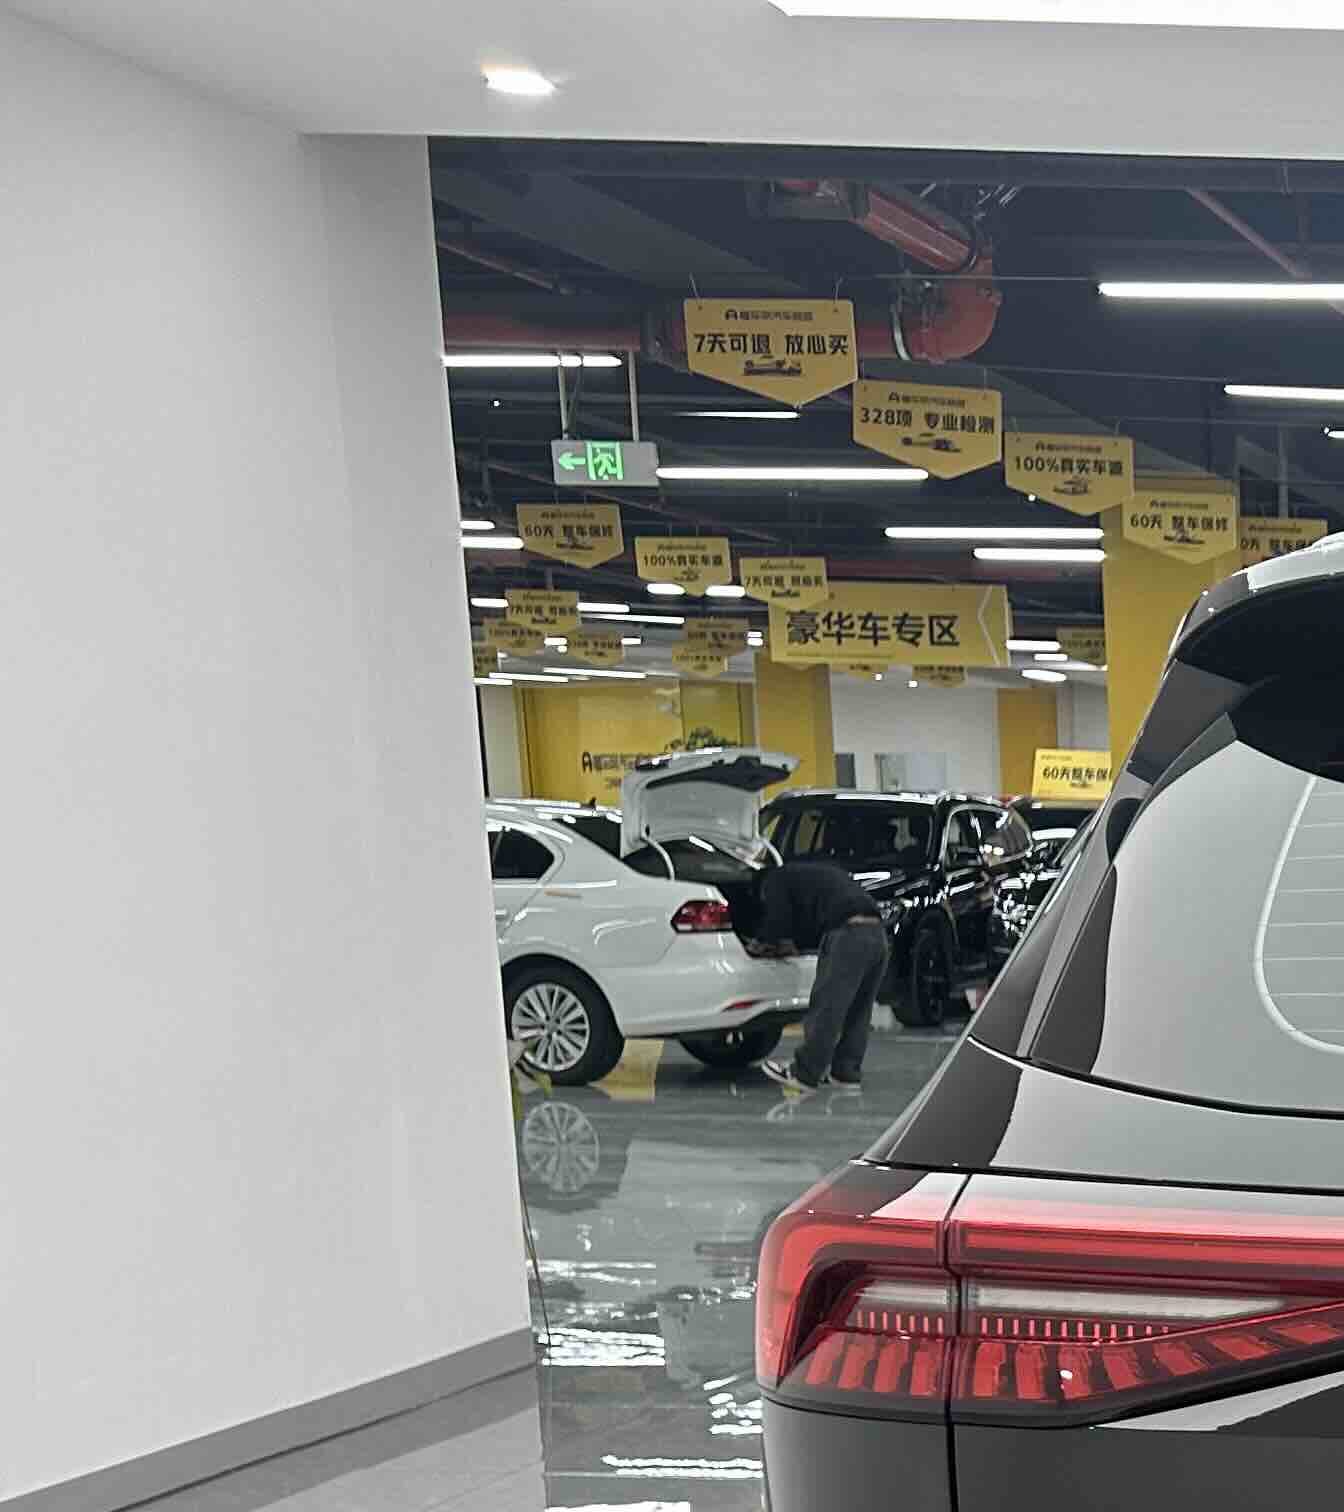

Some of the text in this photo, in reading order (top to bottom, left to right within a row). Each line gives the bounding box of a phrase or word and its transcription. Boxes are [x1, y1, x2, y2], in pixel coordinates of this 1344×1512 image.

[693, 333, 849, 355] 7天可退 放心买
[1130, 514, 1163, 530] 60天
[786, 609, 961, 648] 豪华车专区
